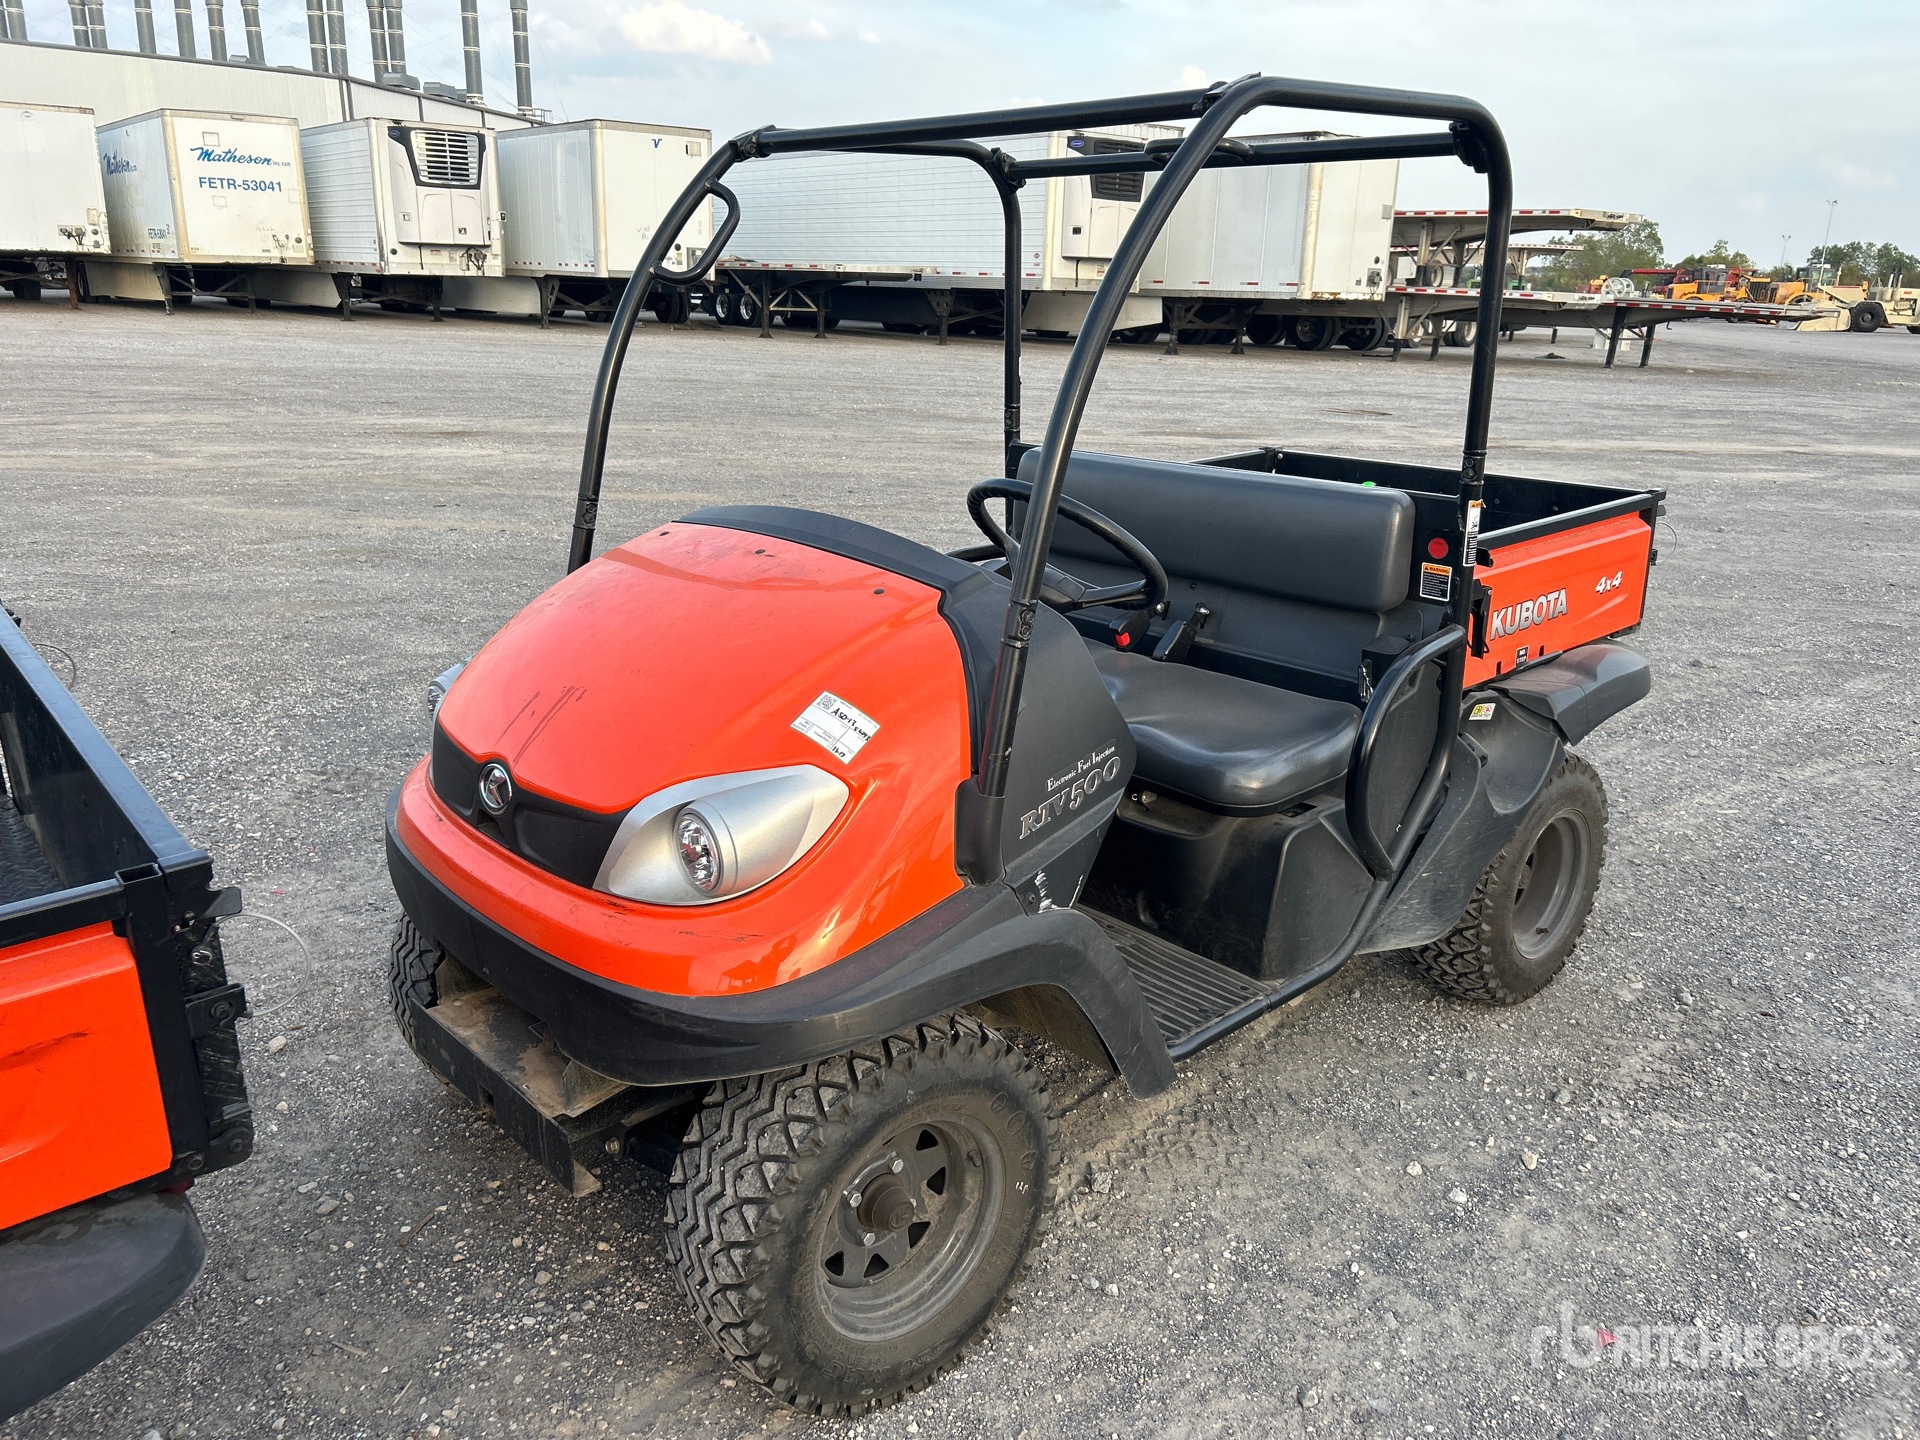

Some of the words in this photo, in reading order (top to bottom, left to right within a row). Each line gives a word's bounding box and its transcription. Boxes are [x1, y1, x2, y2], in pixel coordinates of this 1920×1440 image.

[190, 146, 272, 166] Matheson
[198, 176, 282, 193] FETR-53041
[1429, 565, 1450, 573] WARNING
[1595, 571, 1623, 595] 4x4
[1489, 588, 1568, 640] KUBOTA
[1516, 655, 1527, 664] STEP
[1519, 648, 1526, 656] NO
[1047, 770, 1077, 792] Electronic
[1077, 759, 1091, 774] Fuel
[1091, 746, 1115, 765] Injection
[1019, 756, 1121, 840] RTV500
